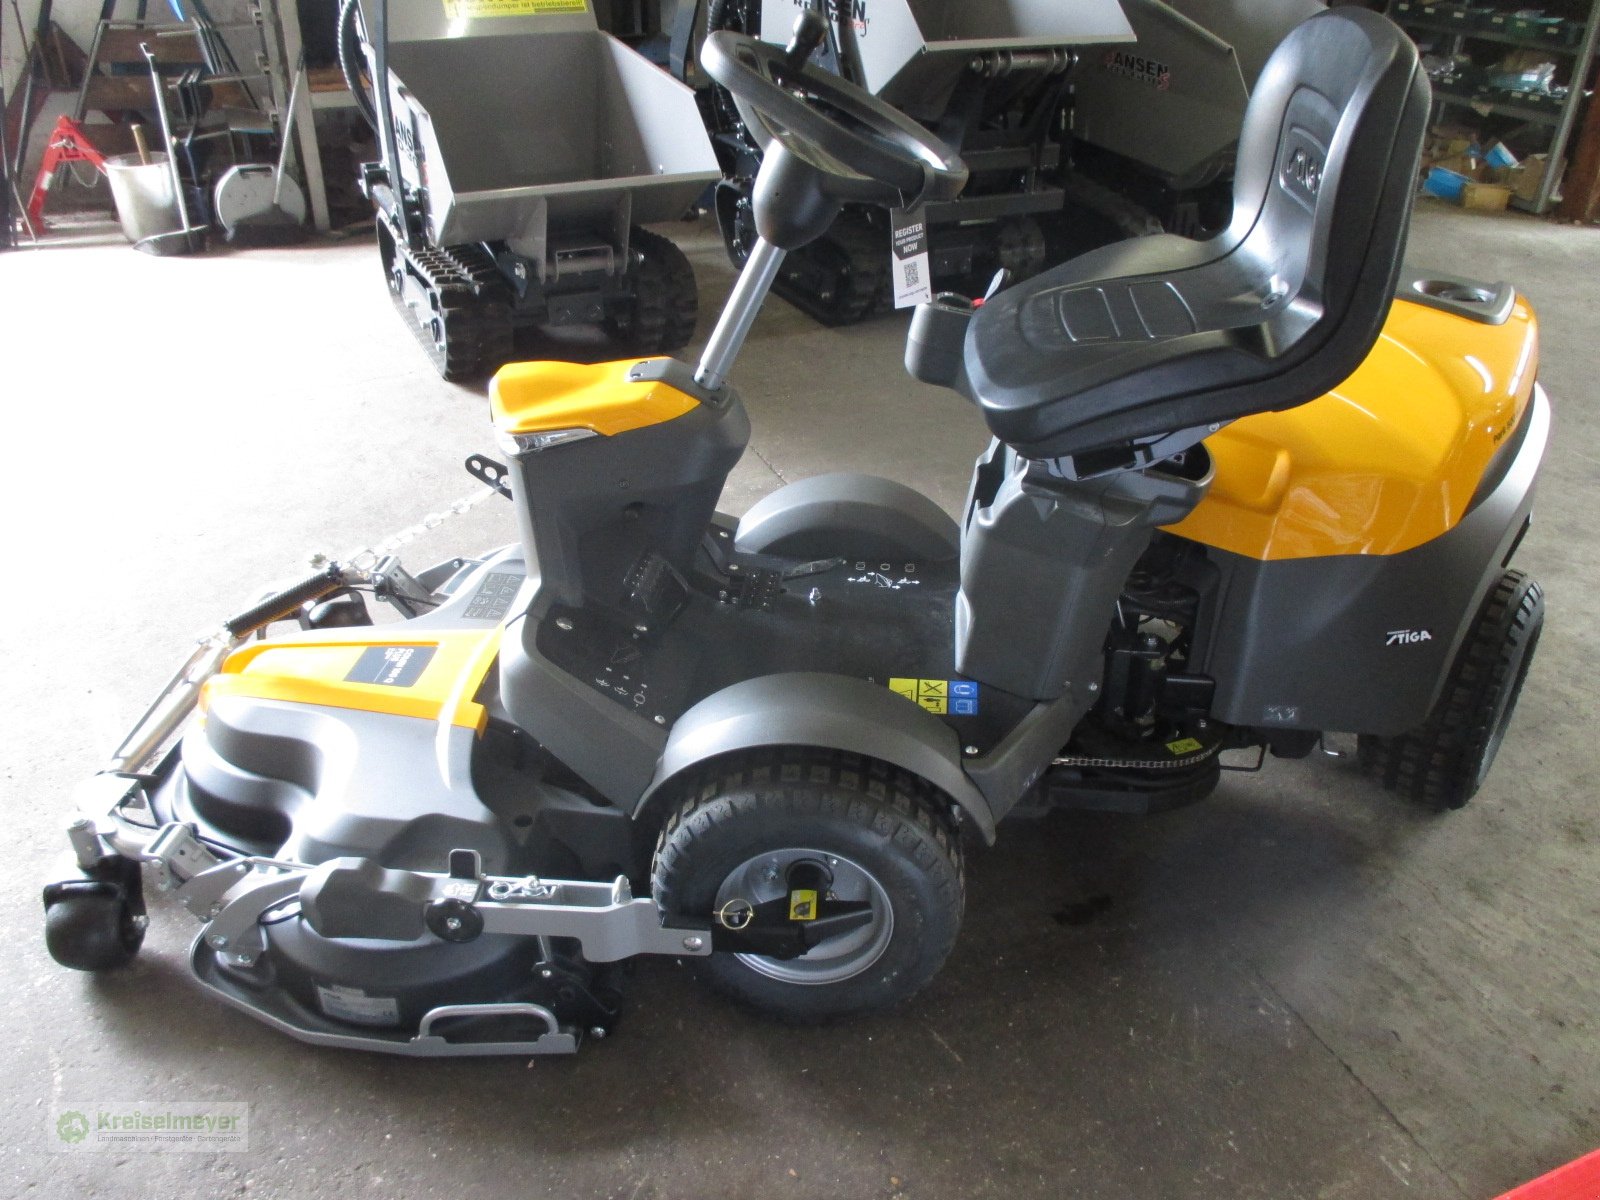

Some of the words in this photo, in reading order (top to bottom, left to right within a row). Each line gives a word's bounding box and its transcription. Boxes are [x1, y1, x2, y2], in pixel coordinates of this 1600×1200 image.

[894, 222, 923, 239] REGISTER
[906, 232, 924, 243] PRODUCT
[903, 241, 918, 254] NOW
[1386, 629, 1432, 646] STIGA
